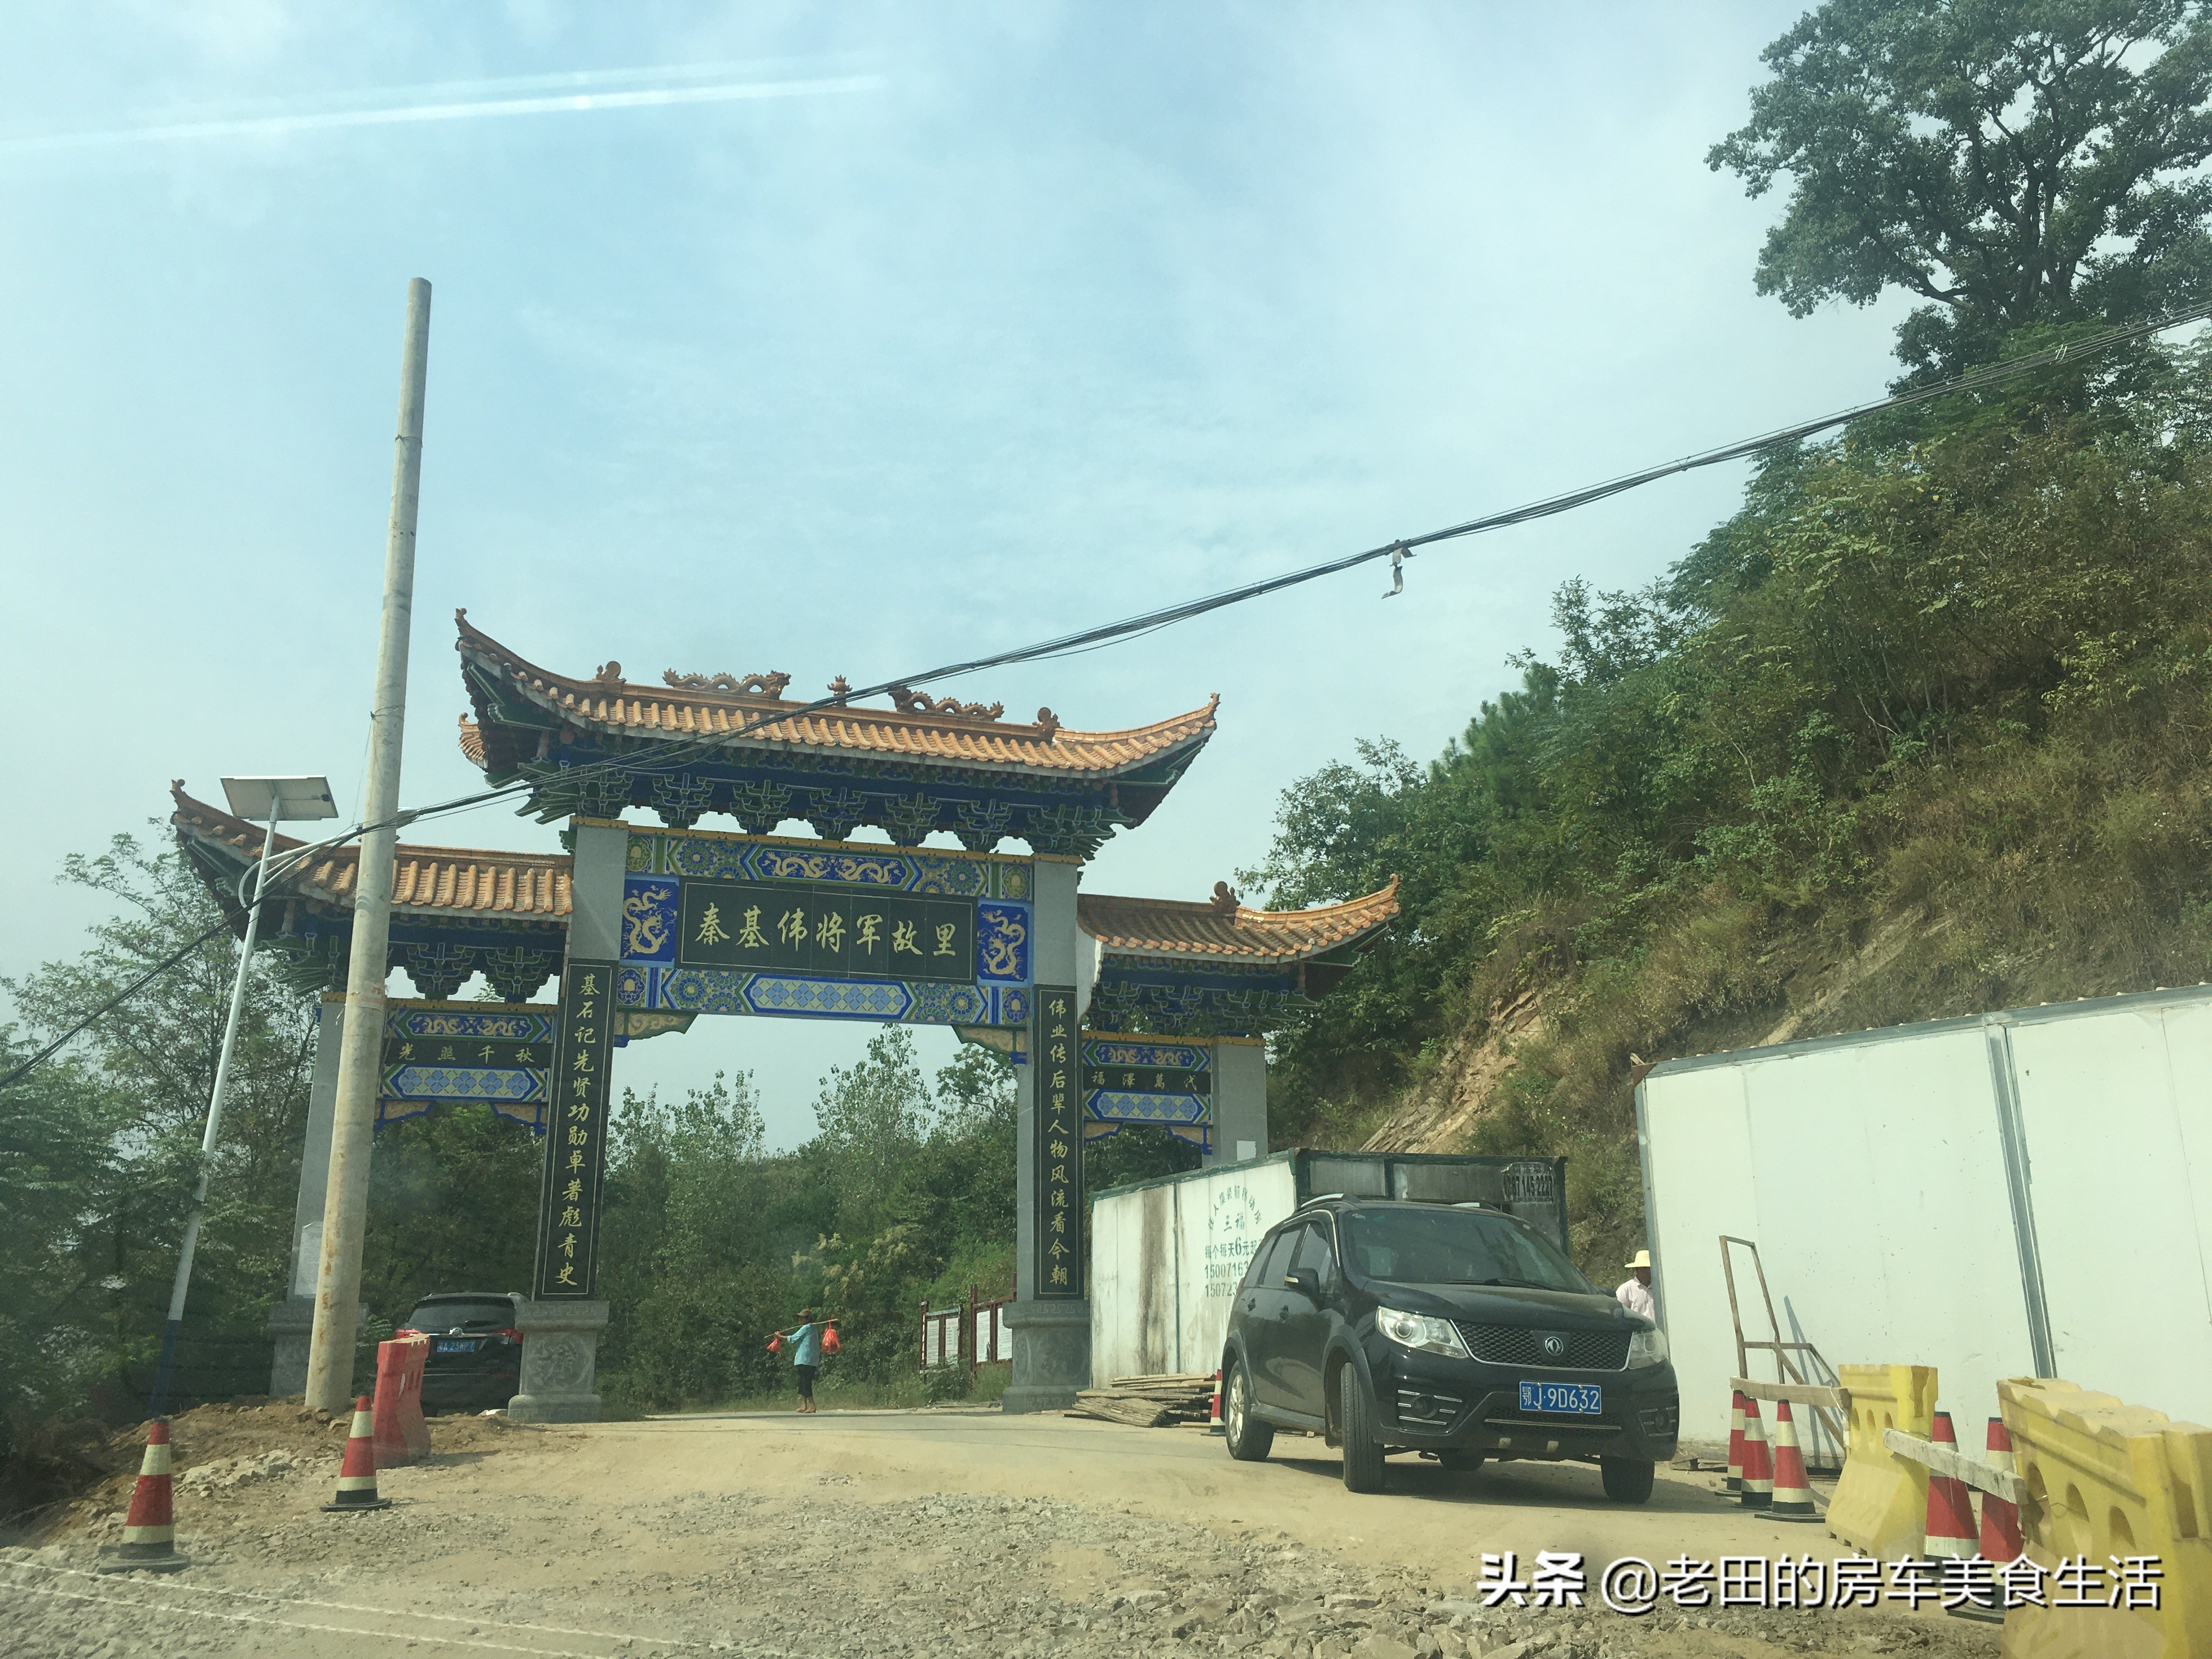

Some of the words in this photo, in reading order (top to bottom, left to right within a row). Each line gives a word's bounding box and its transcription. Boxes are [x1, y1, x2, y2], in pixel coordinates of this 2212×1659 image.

[695, 902, 956, 956] 秦基伟将军故里
[399, 1043, 535, 1064] 光照千秋
[1205, 1237, 1262, 1259] 每个每天6元起
